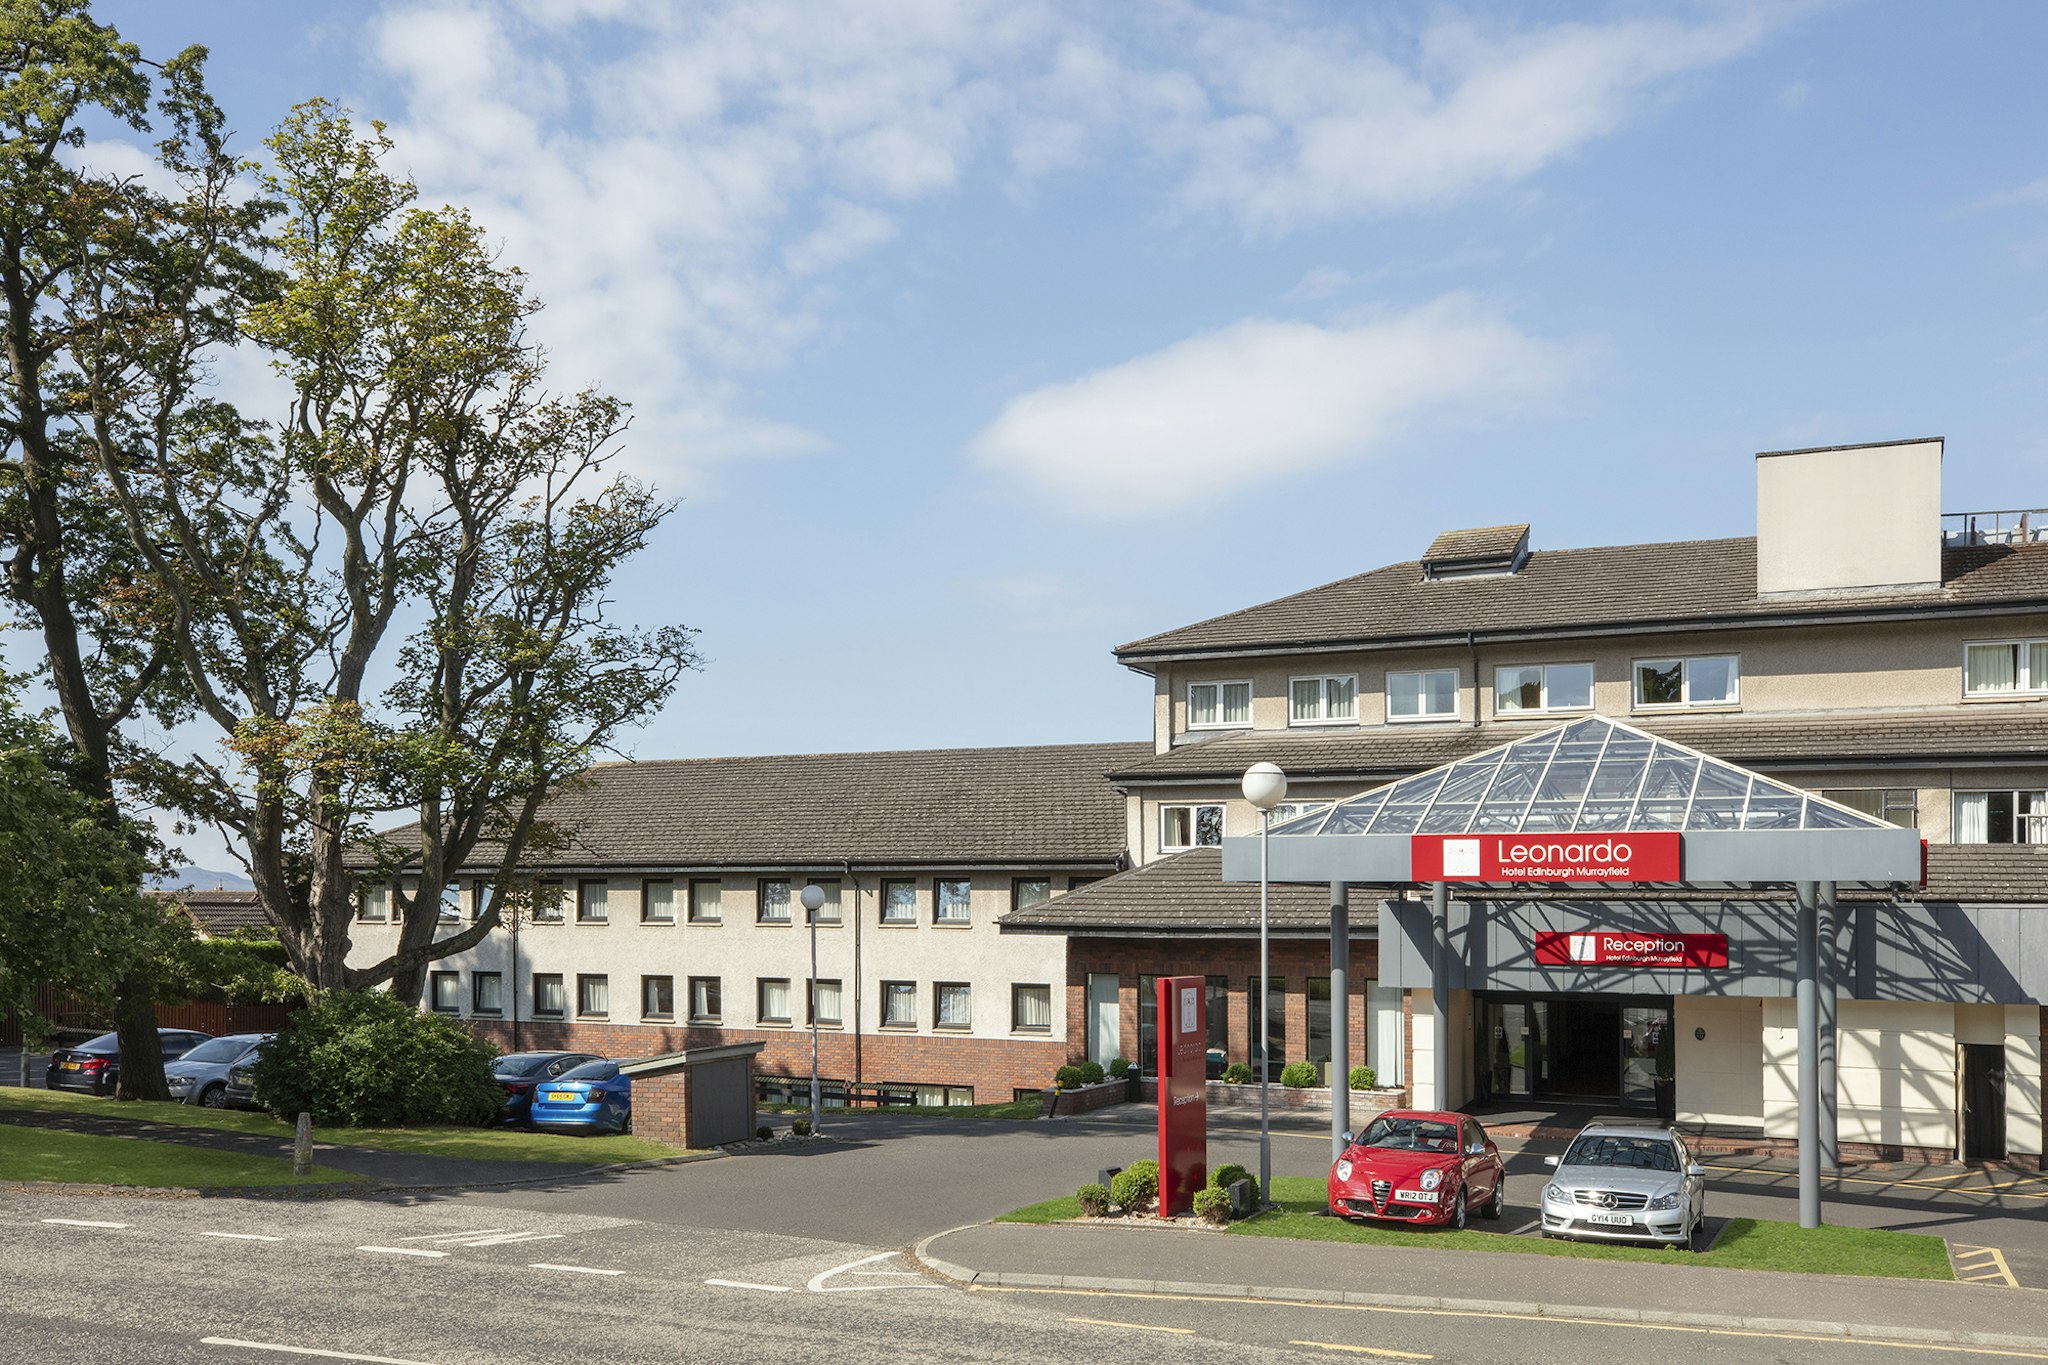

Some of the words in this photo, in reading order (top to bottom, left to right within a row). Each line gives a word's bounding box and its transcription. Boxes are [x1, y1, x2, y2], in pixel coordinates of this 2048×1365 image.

[1498, 839, 1632, 863] Leonardo
[1501, 867, 1525, 876] Hotel
[1527, 867, 1574, 878] Edinburgh
[1576, 867, 1629, 878] Murrayfield
[1603, 937, 1685, 954] Reception
[1173, 1093, 1194, 1106] Reception
[1400, 1191, 1417, 1199] WR12
[1418, 1192, 1434, 1201] OTJ
[1591, 1214, 1609, 1223] GY14
[1611, 1216, 1627, 1224] UUO
